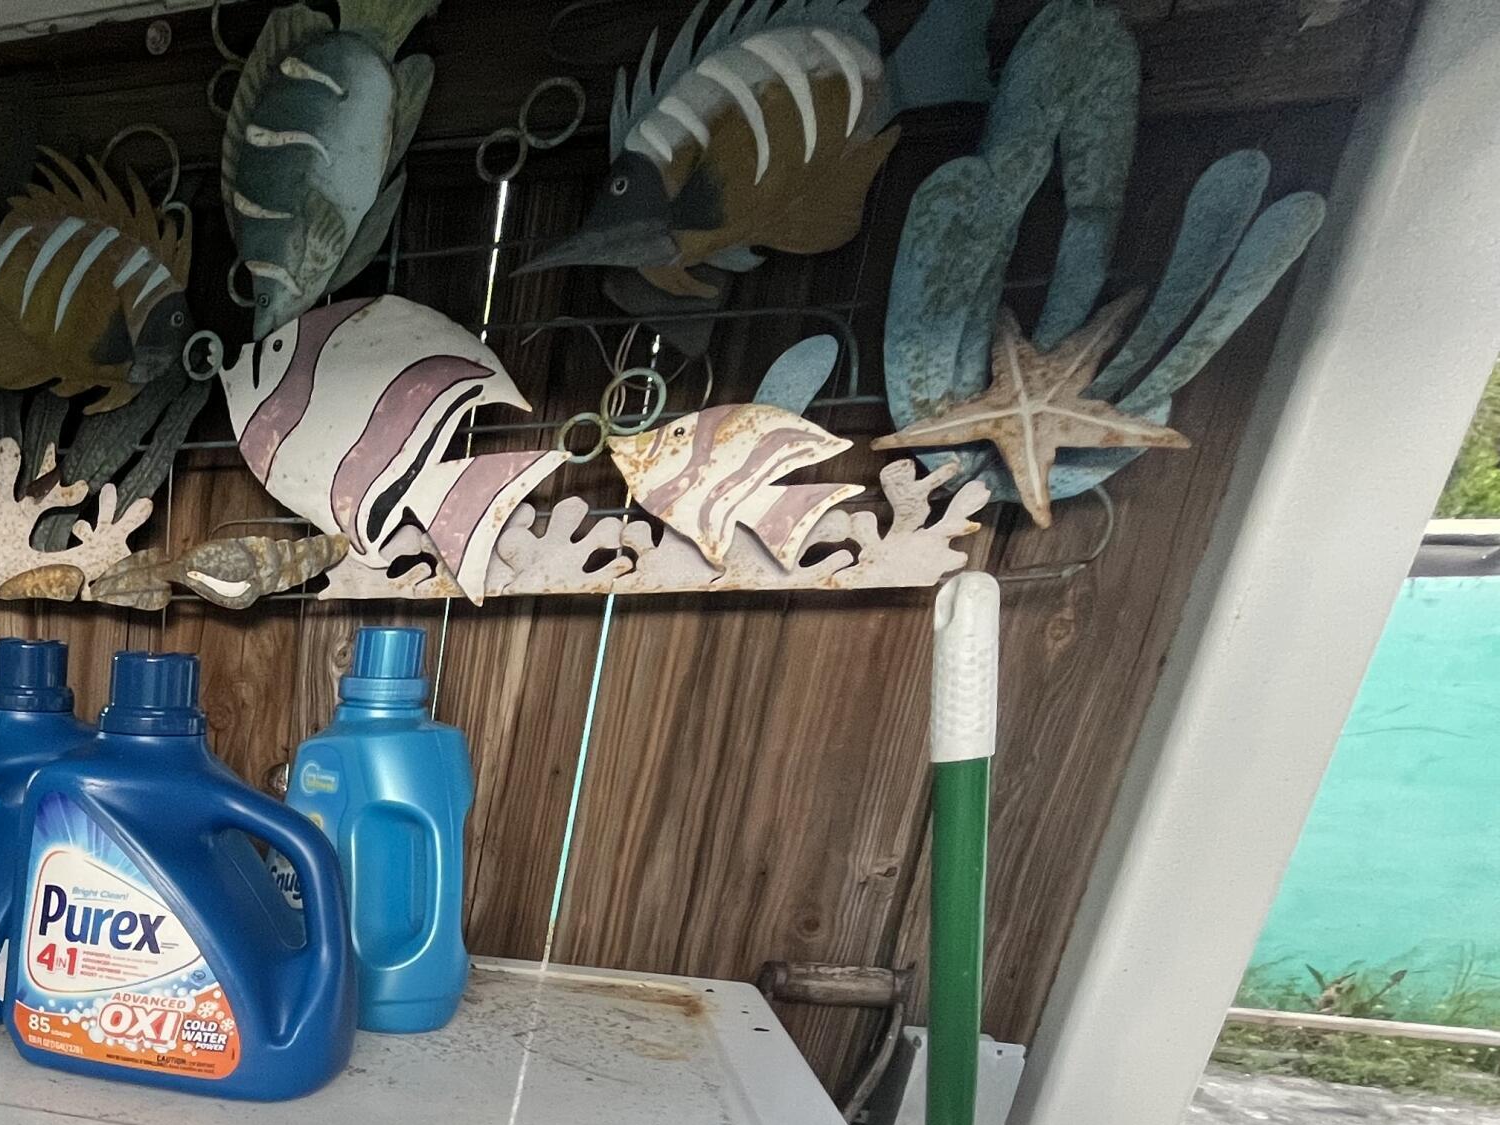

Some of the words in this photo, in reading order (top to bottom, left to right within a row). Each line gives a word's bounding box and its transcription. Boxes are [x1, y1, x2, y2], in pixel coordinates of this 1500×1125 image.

[72, 886, 99, 898] Bright
[39, 884, 166, 954] Purex
[37, 943, 57, 972] 4
[56, 957, 67, 969] IN
[66, 947, 78, 975] 1
[112, 992, 187, 1009] ADVANCED
[28, 1013, 51, 1033] 85
[100, 1003, 182, 1044] OXI
[183, 1020, 218, 1032] COLD
[181, 1030, 227, 1045] WATER
[195, 1042, 225, 1051] POWER
